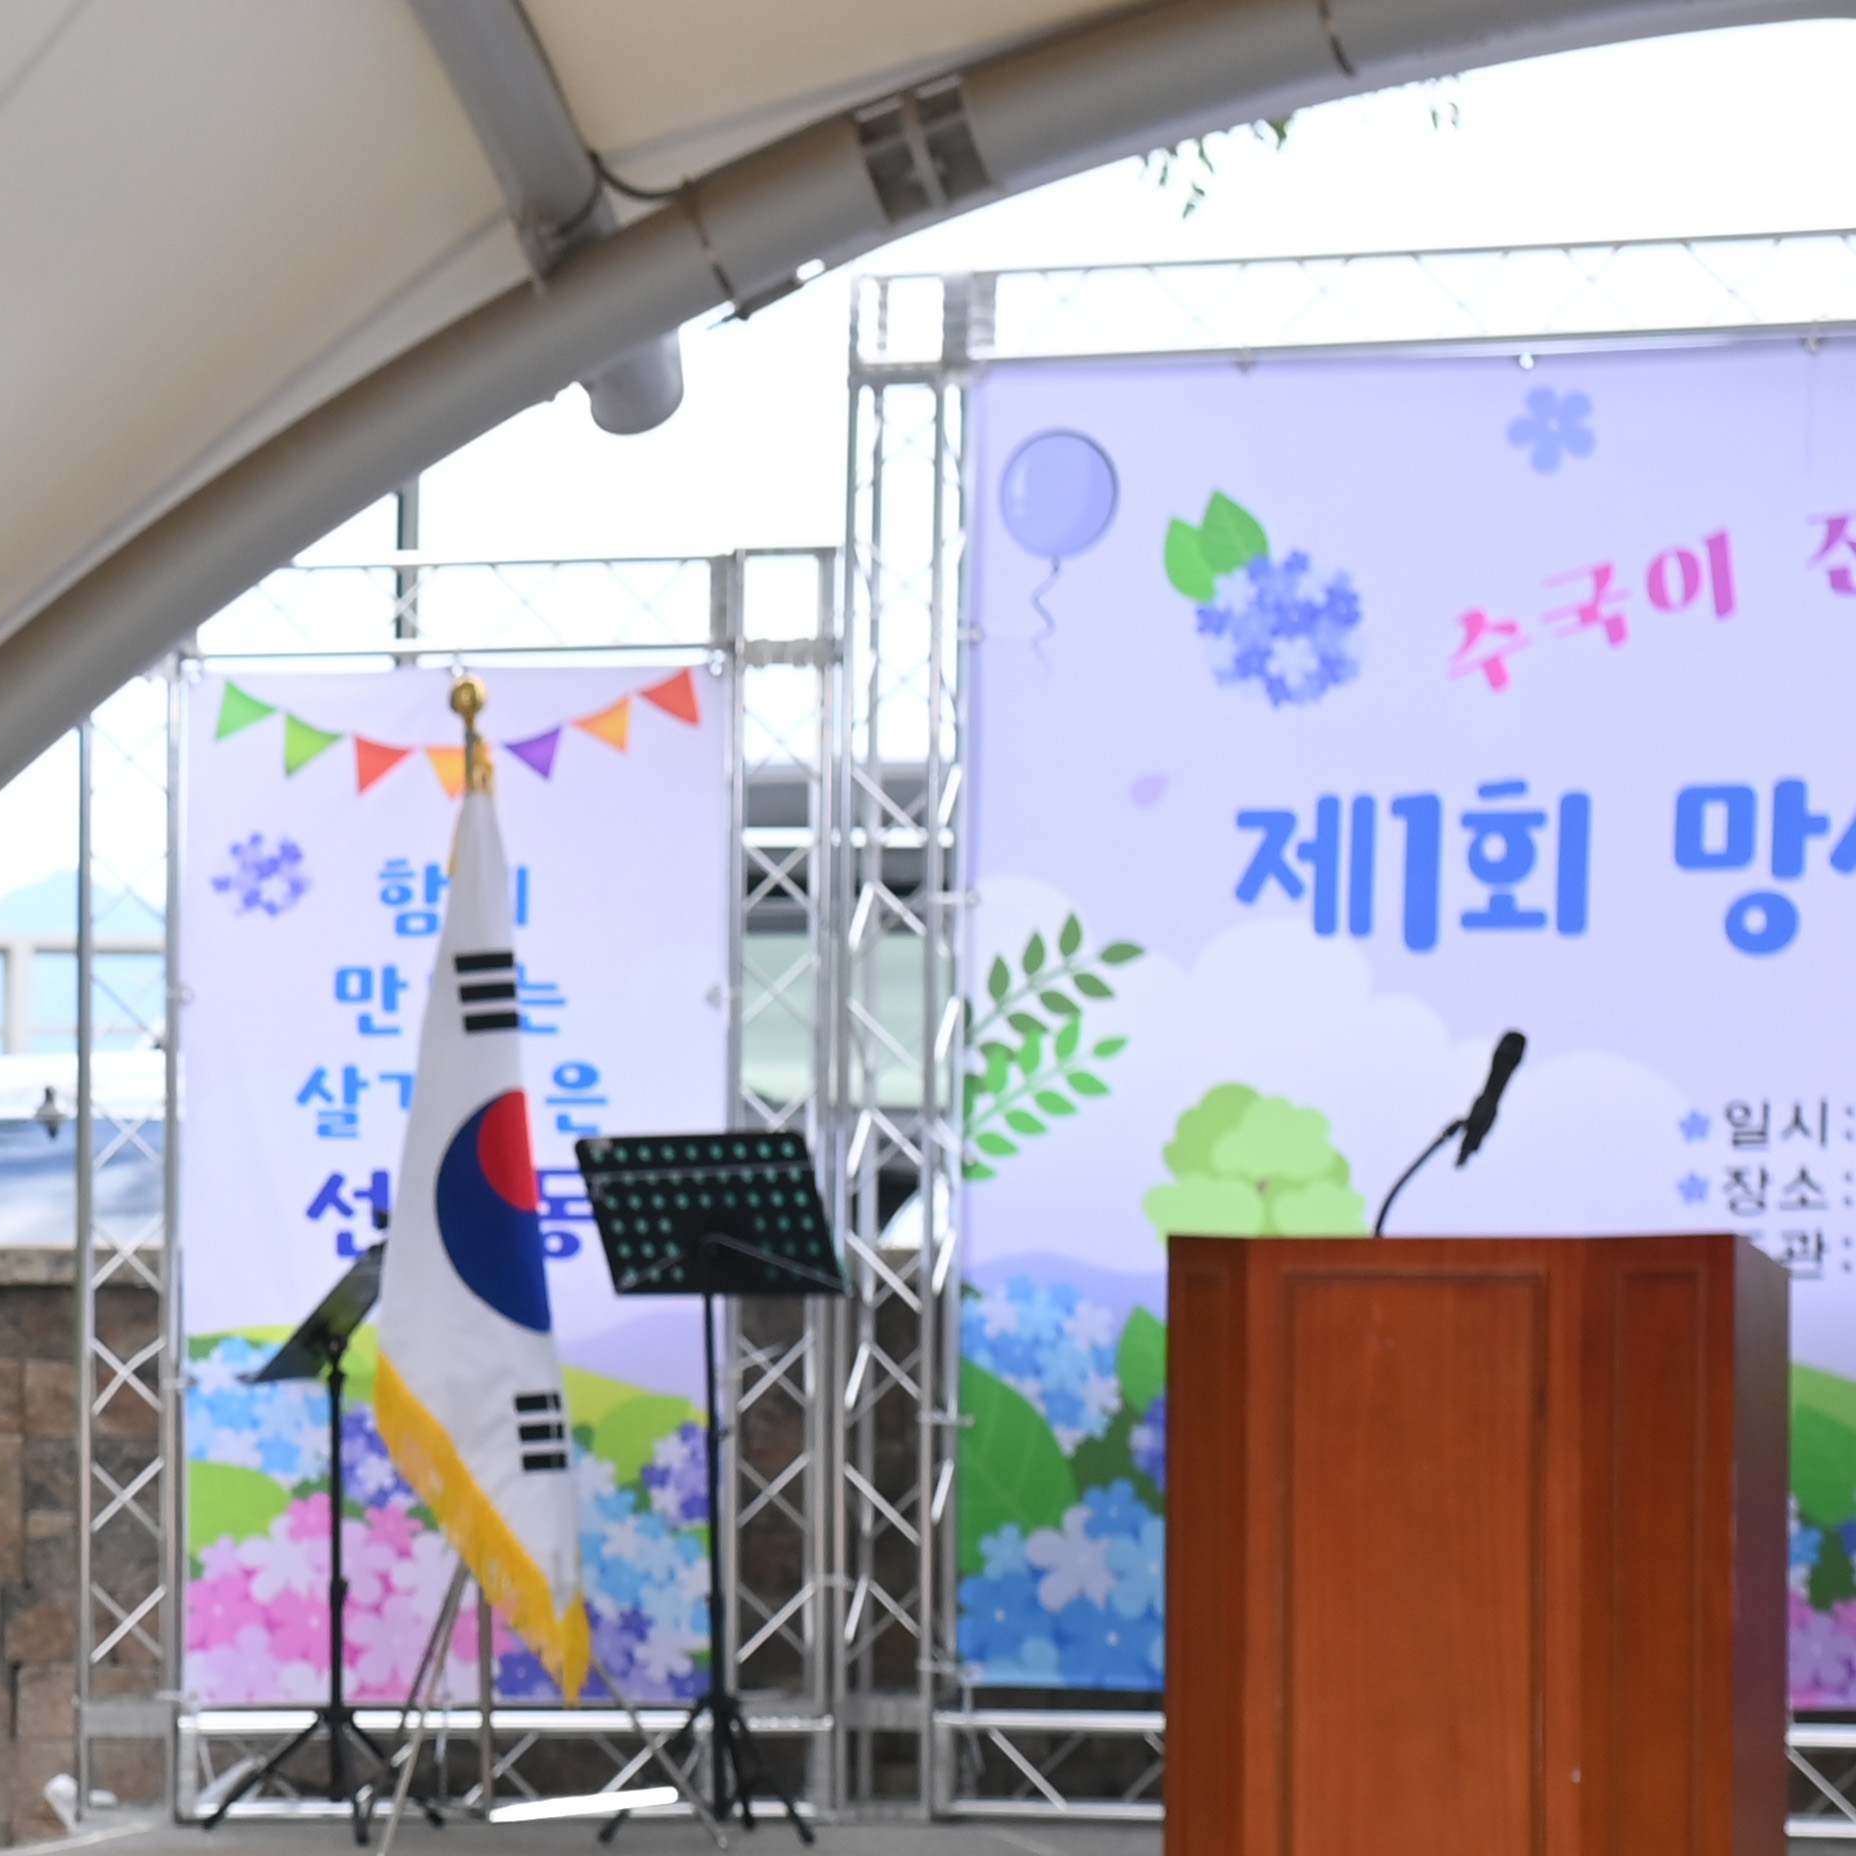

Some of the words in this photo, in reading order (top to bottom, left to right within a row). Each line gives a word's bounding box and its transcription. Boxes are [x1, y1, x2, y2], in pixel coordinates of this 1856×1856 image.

[1448, 528, 1735, 692] 수국이
[1234, 778, 1592, 954] 제1회
[334, 962, 568, 1037] 만는
[305, 1168, 594, 1262] 선동
